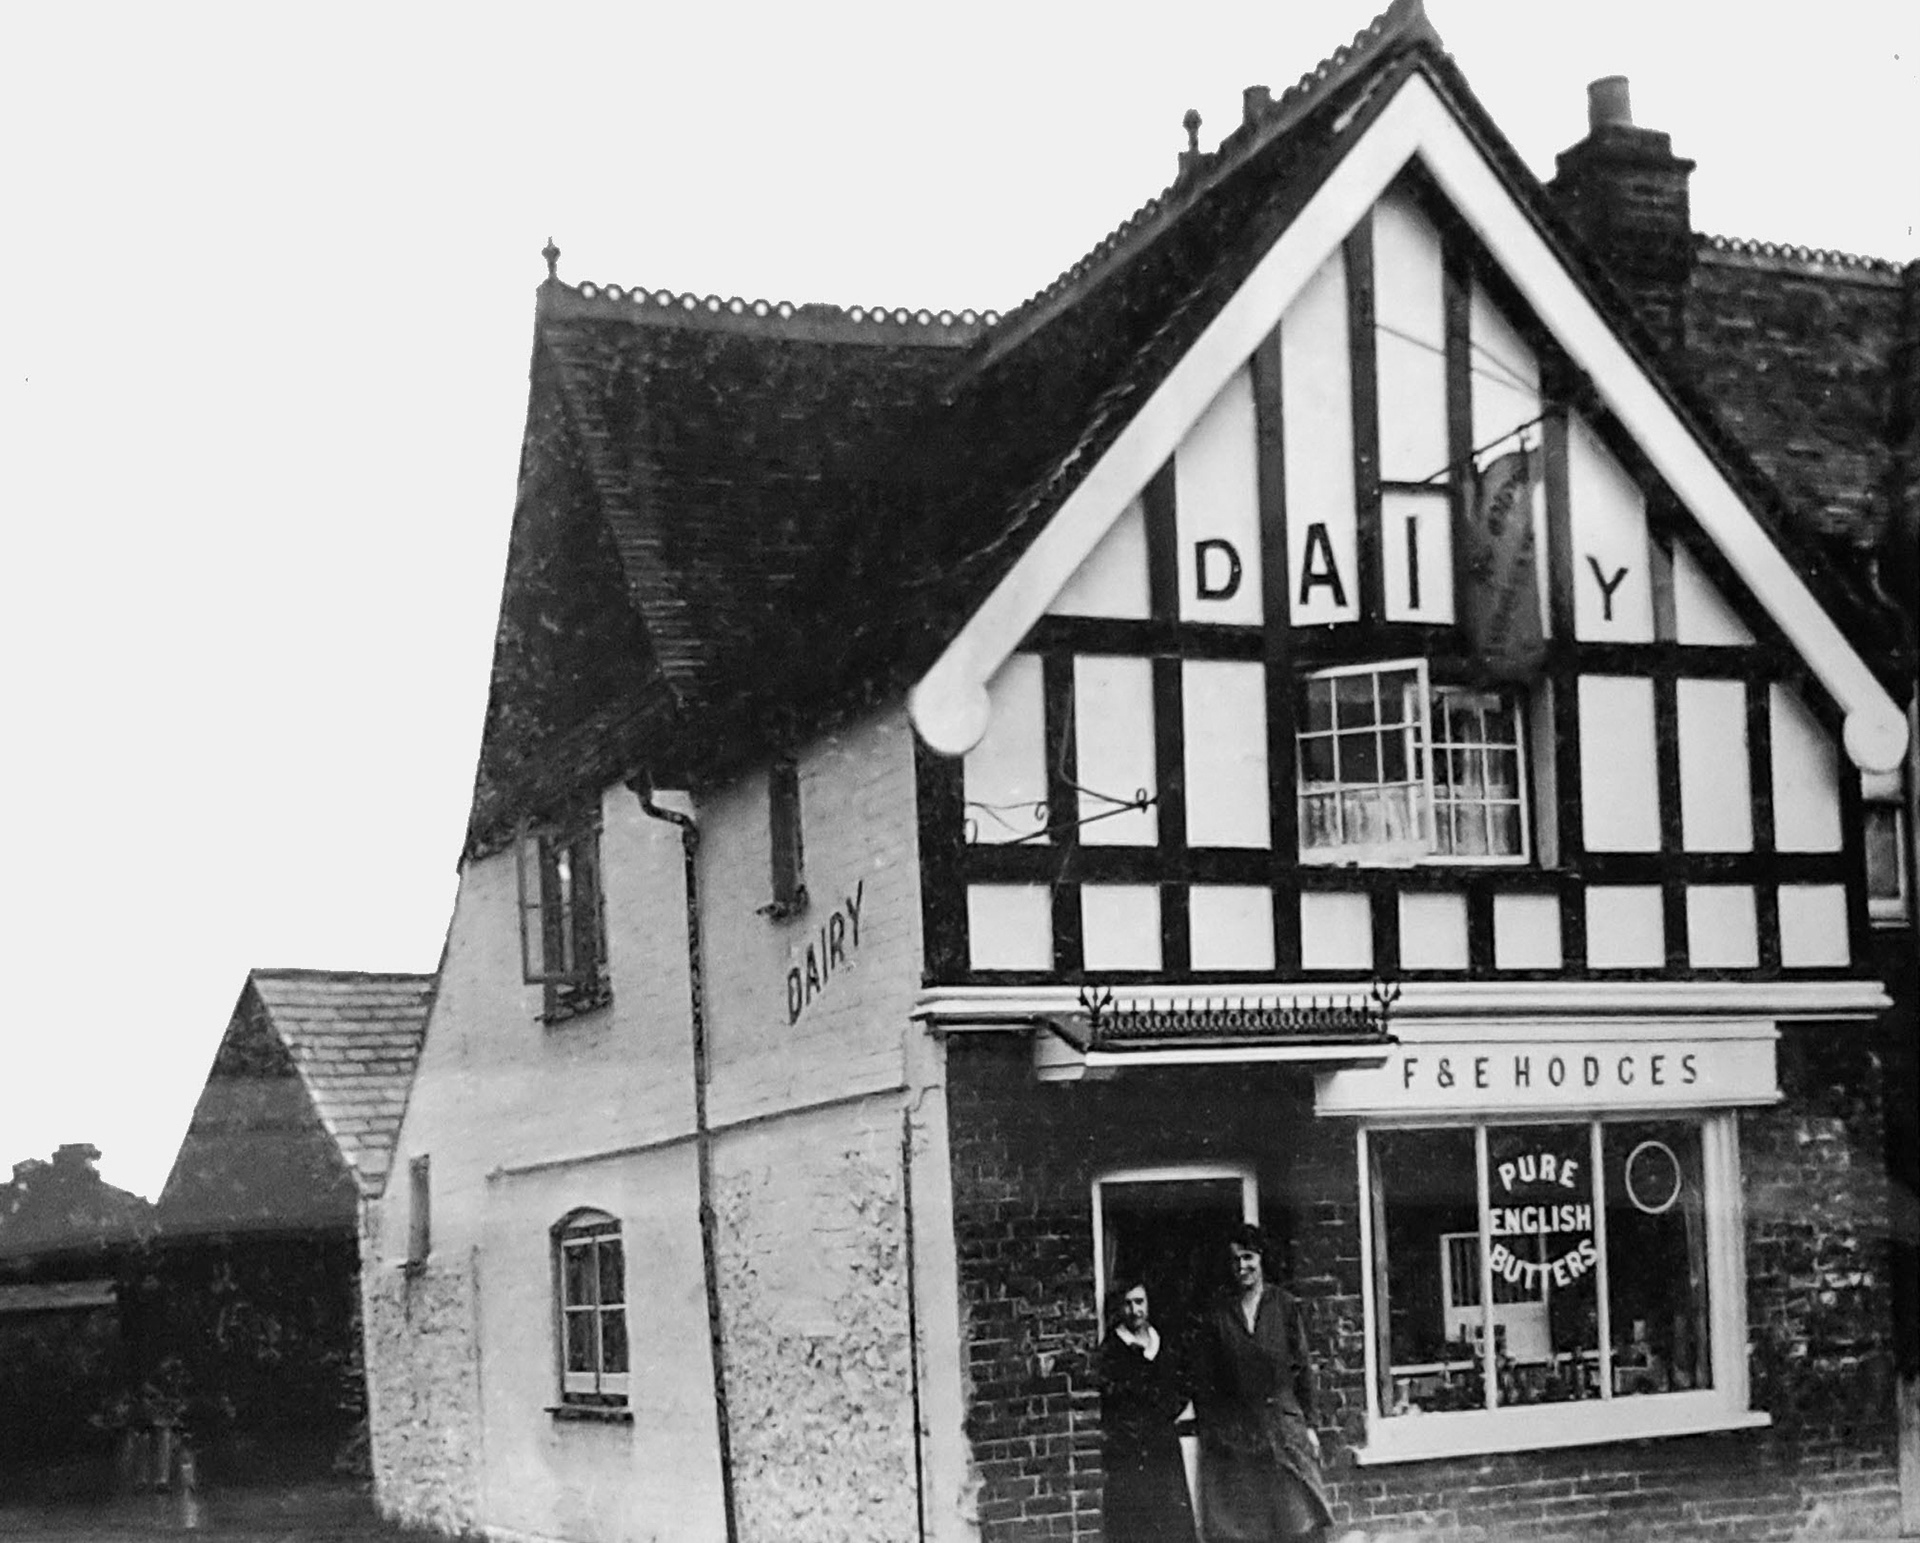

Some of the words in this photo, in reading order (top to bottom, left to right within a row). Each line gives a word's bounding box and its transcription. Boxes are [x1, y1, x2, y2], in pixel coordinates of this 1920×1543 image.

[1195, 516, 1628, 621] DAIY
[788, 880, 863, 1026] DAIRY
[1403, 1057, 1418, 1088] F
[1437, 1058, 1455, 1088] &
[1475, 1056, 1489, 1088] E
[1498, 1153, 1578, 1191] PURE
[1488, 1204, 1593, 1235] ENGLISH
[1488, 1239, 1598, 1290] BUTTERS
